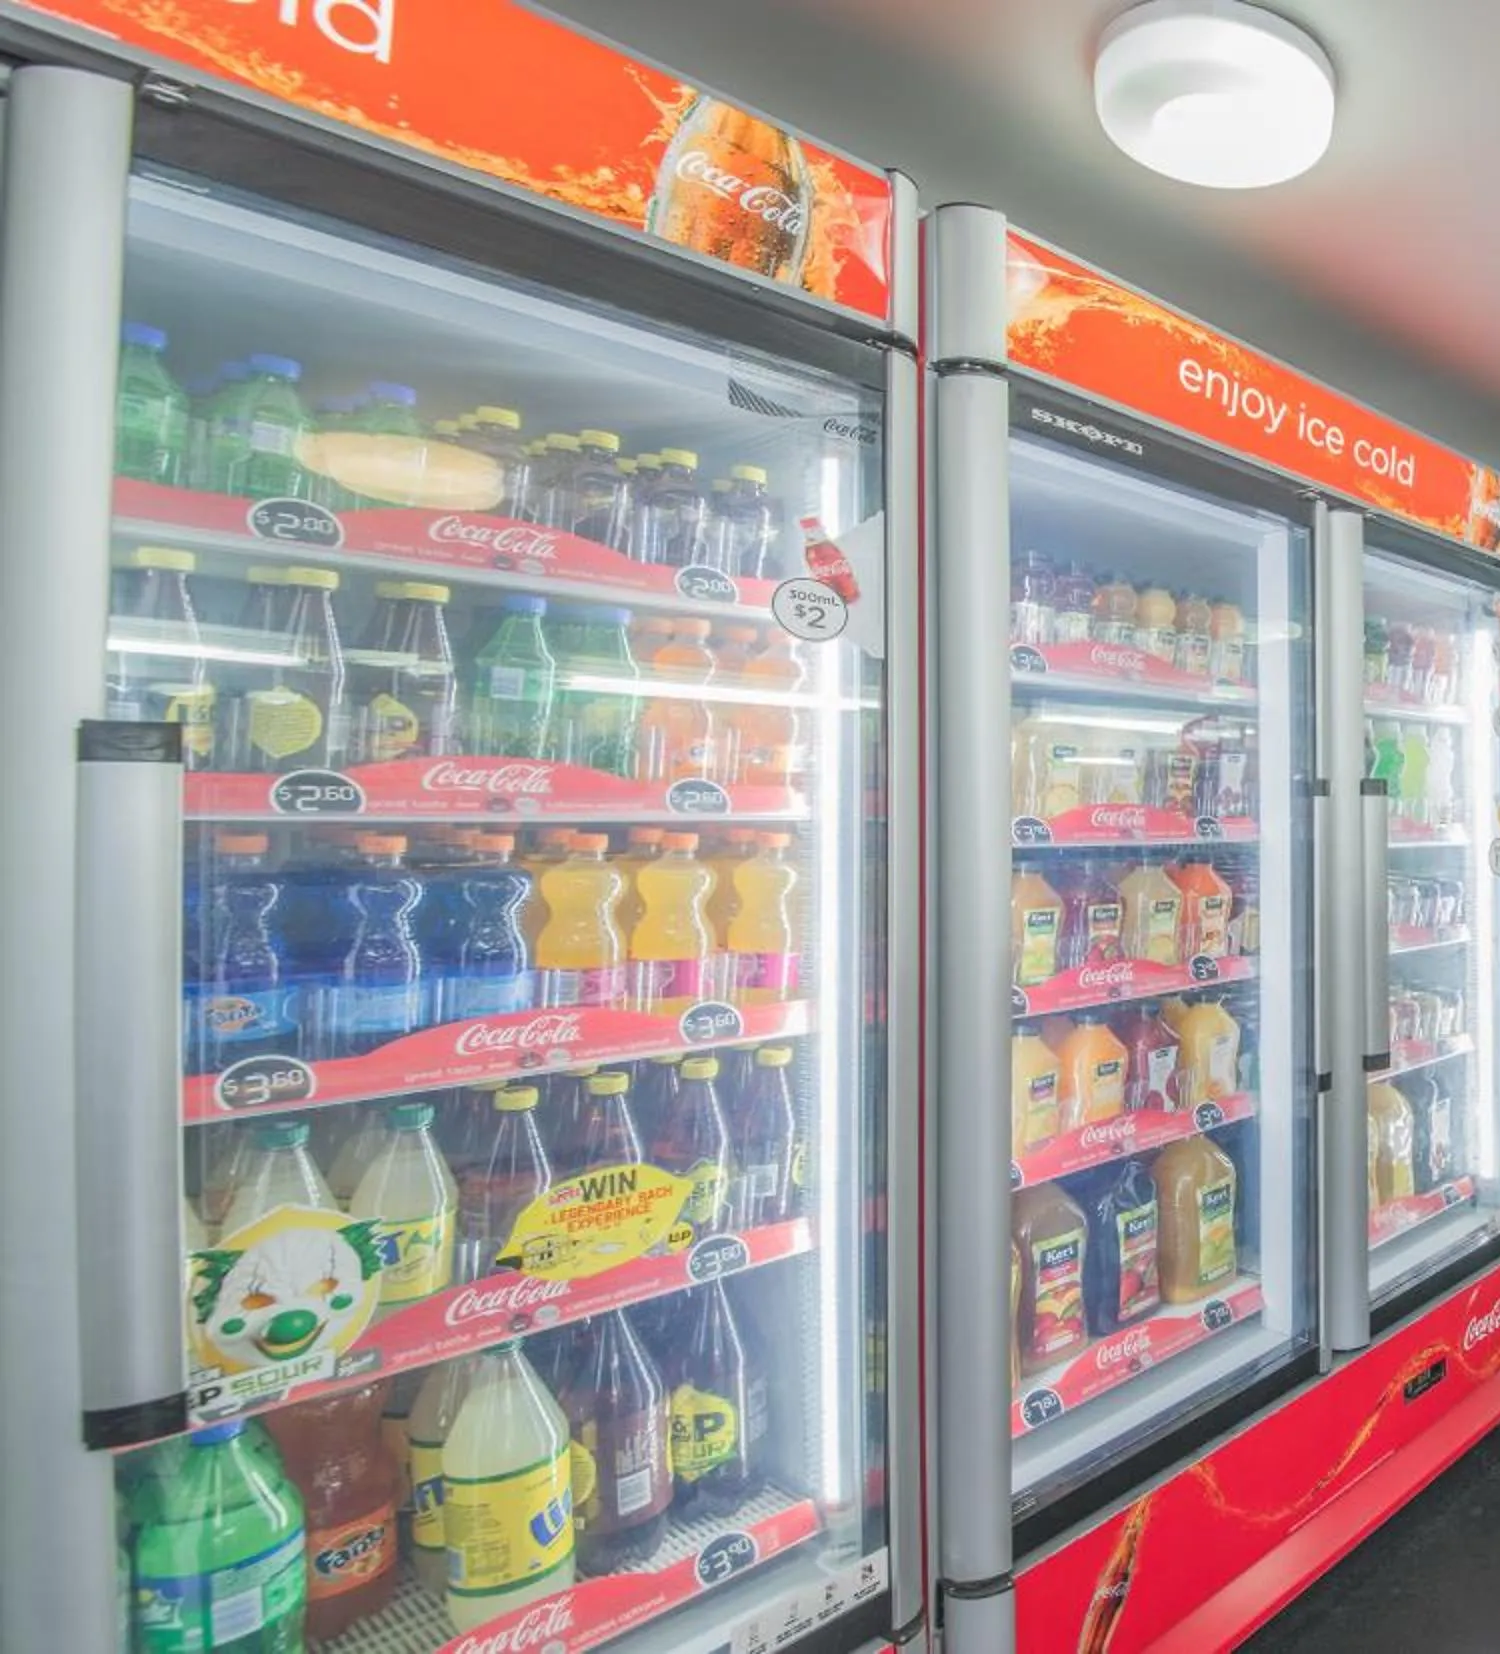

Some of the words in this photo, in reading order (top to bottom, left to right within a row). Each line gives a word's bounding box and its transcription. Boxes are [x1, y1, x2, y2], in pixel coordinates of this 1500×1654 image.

[1179, 358, 1288, 435] enjoy
[1299, 403, 1345, 455] ice
[1353, 437, 1416, 487] cold
[428, 515, 558, 559] Coca-Cola
[795, 604, 827, 630] $2
[422, 761, 554, 794] Coca-Cola
[456, 1013, 584, 1054] Coca-Cola
[579, 1169, 637, 1202] WIN
[551, 1195, 632, 1225] LEGENDARY
[230, 1355, 324, 1394] SOUR
